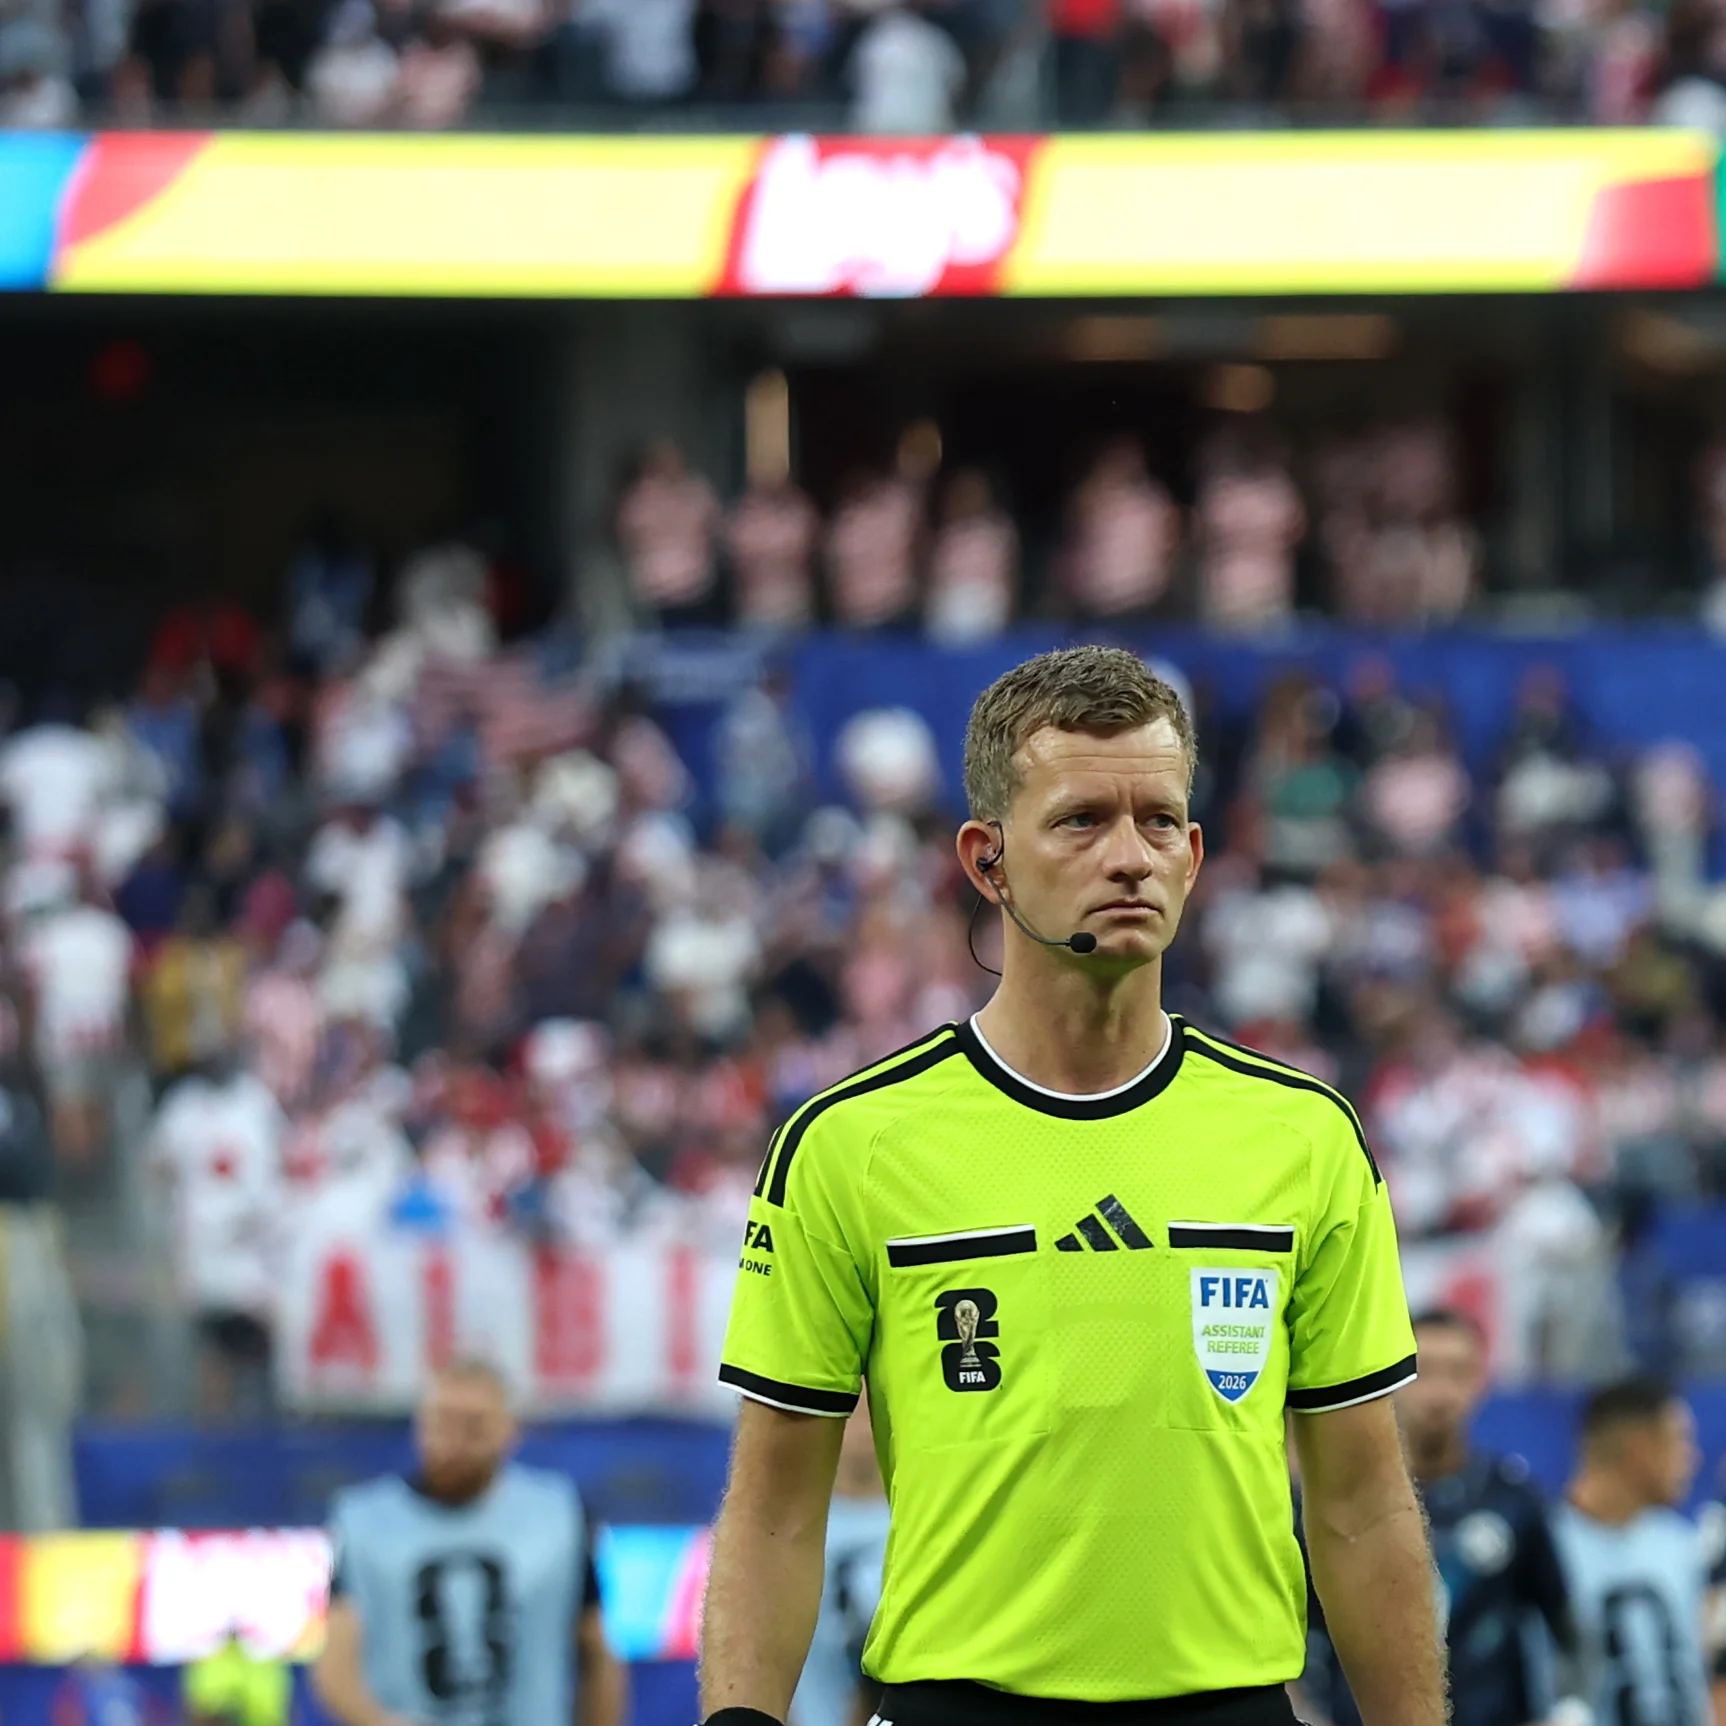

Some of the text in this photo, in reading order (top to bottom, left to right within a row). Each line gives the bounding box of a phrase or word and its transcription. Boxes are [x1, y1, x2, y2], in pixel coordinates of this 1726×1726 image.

[744, 1220, 775, 1253] FA
[745, 1260, 772, 1276] ONE
[1200, 1277, 1269, 1309] FIFA
[1202, 1324, 1265, 1339] ASSISTANT
[1208, 1340, 1259, 1354] REFEREE
[959, 1371, 986, 1384] FIFA
[1218, 1375, 1247, 1389] 2026
